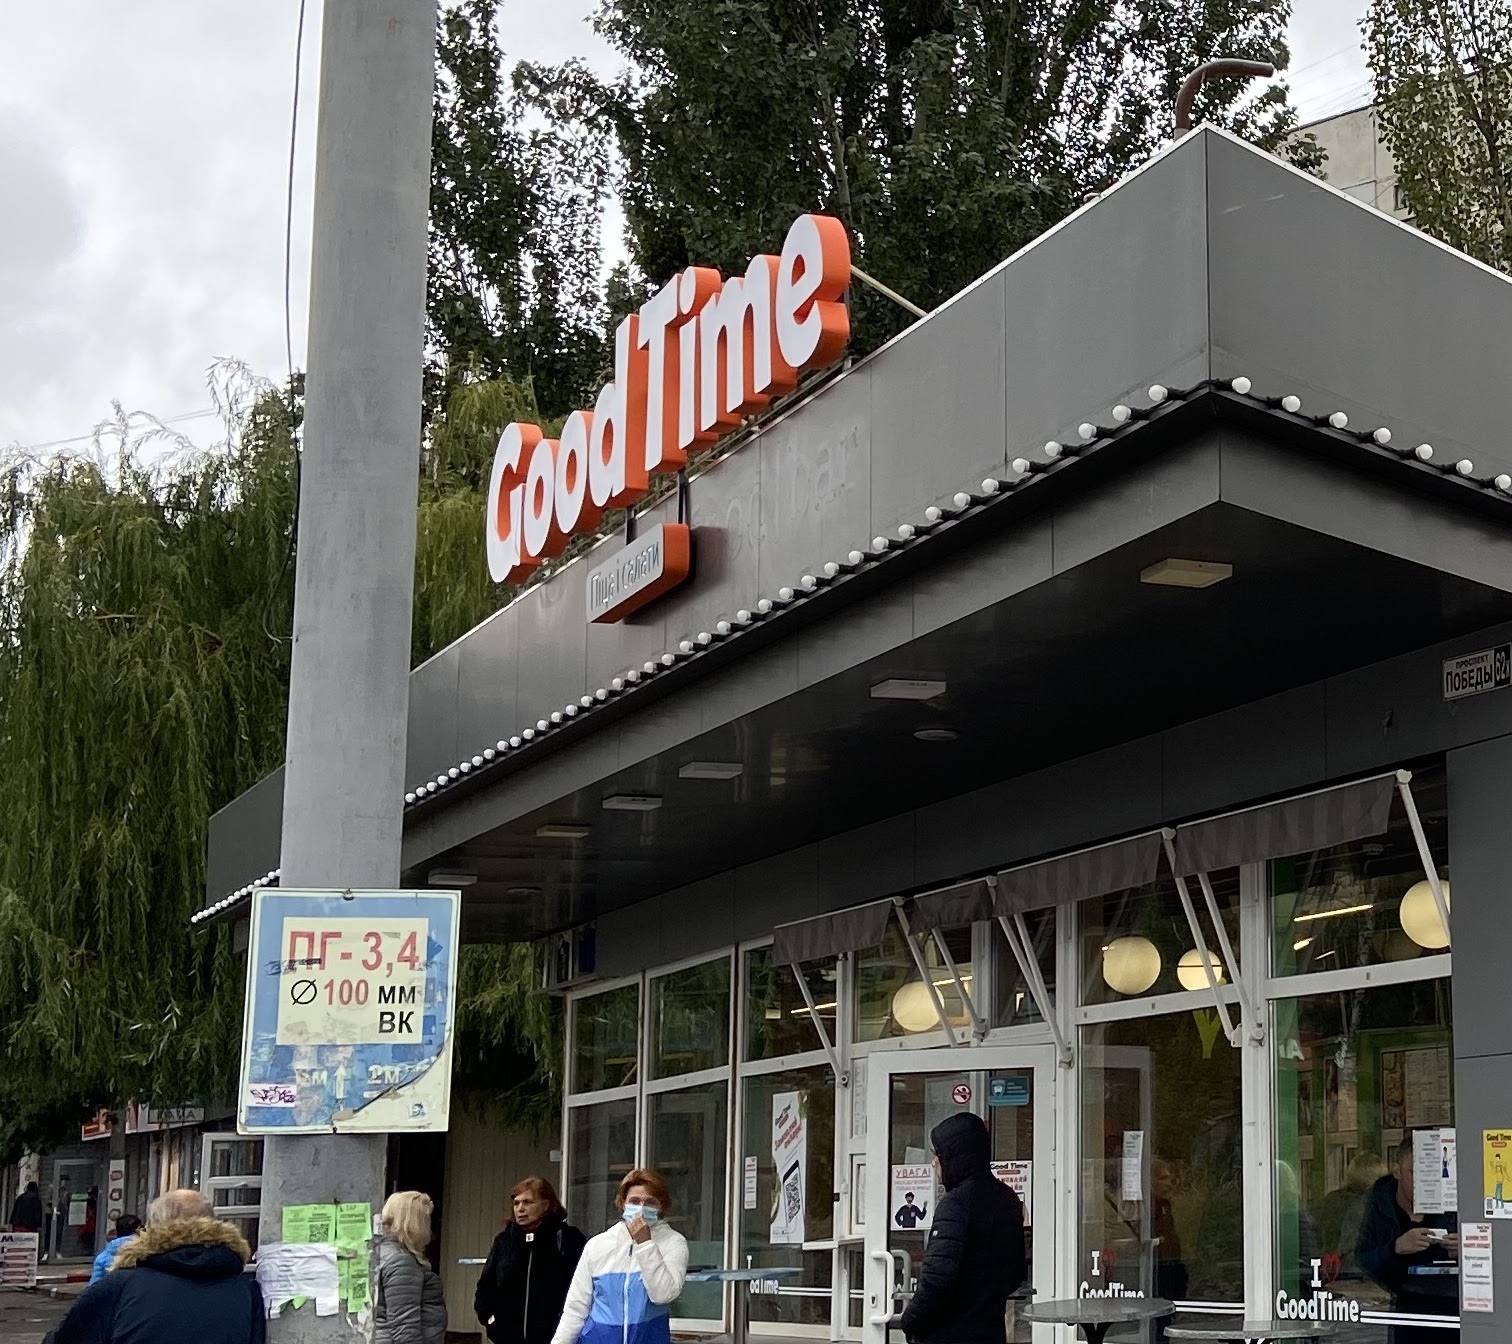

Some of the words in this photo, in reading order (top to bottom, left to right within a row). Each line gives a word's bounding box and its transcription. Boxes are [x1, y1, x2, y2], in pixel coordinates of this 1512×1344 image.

[622, 541, 660, 589] салати
[1446, 664, 1493, 693] ПОБЕДЫ
[324, 979, 369, 1006] 100
[378, 1011, 415, 1034] ВК
[989, 1162, 1009, 1170] Good
[1276, 1289, 1359, 1322] GoodTime
